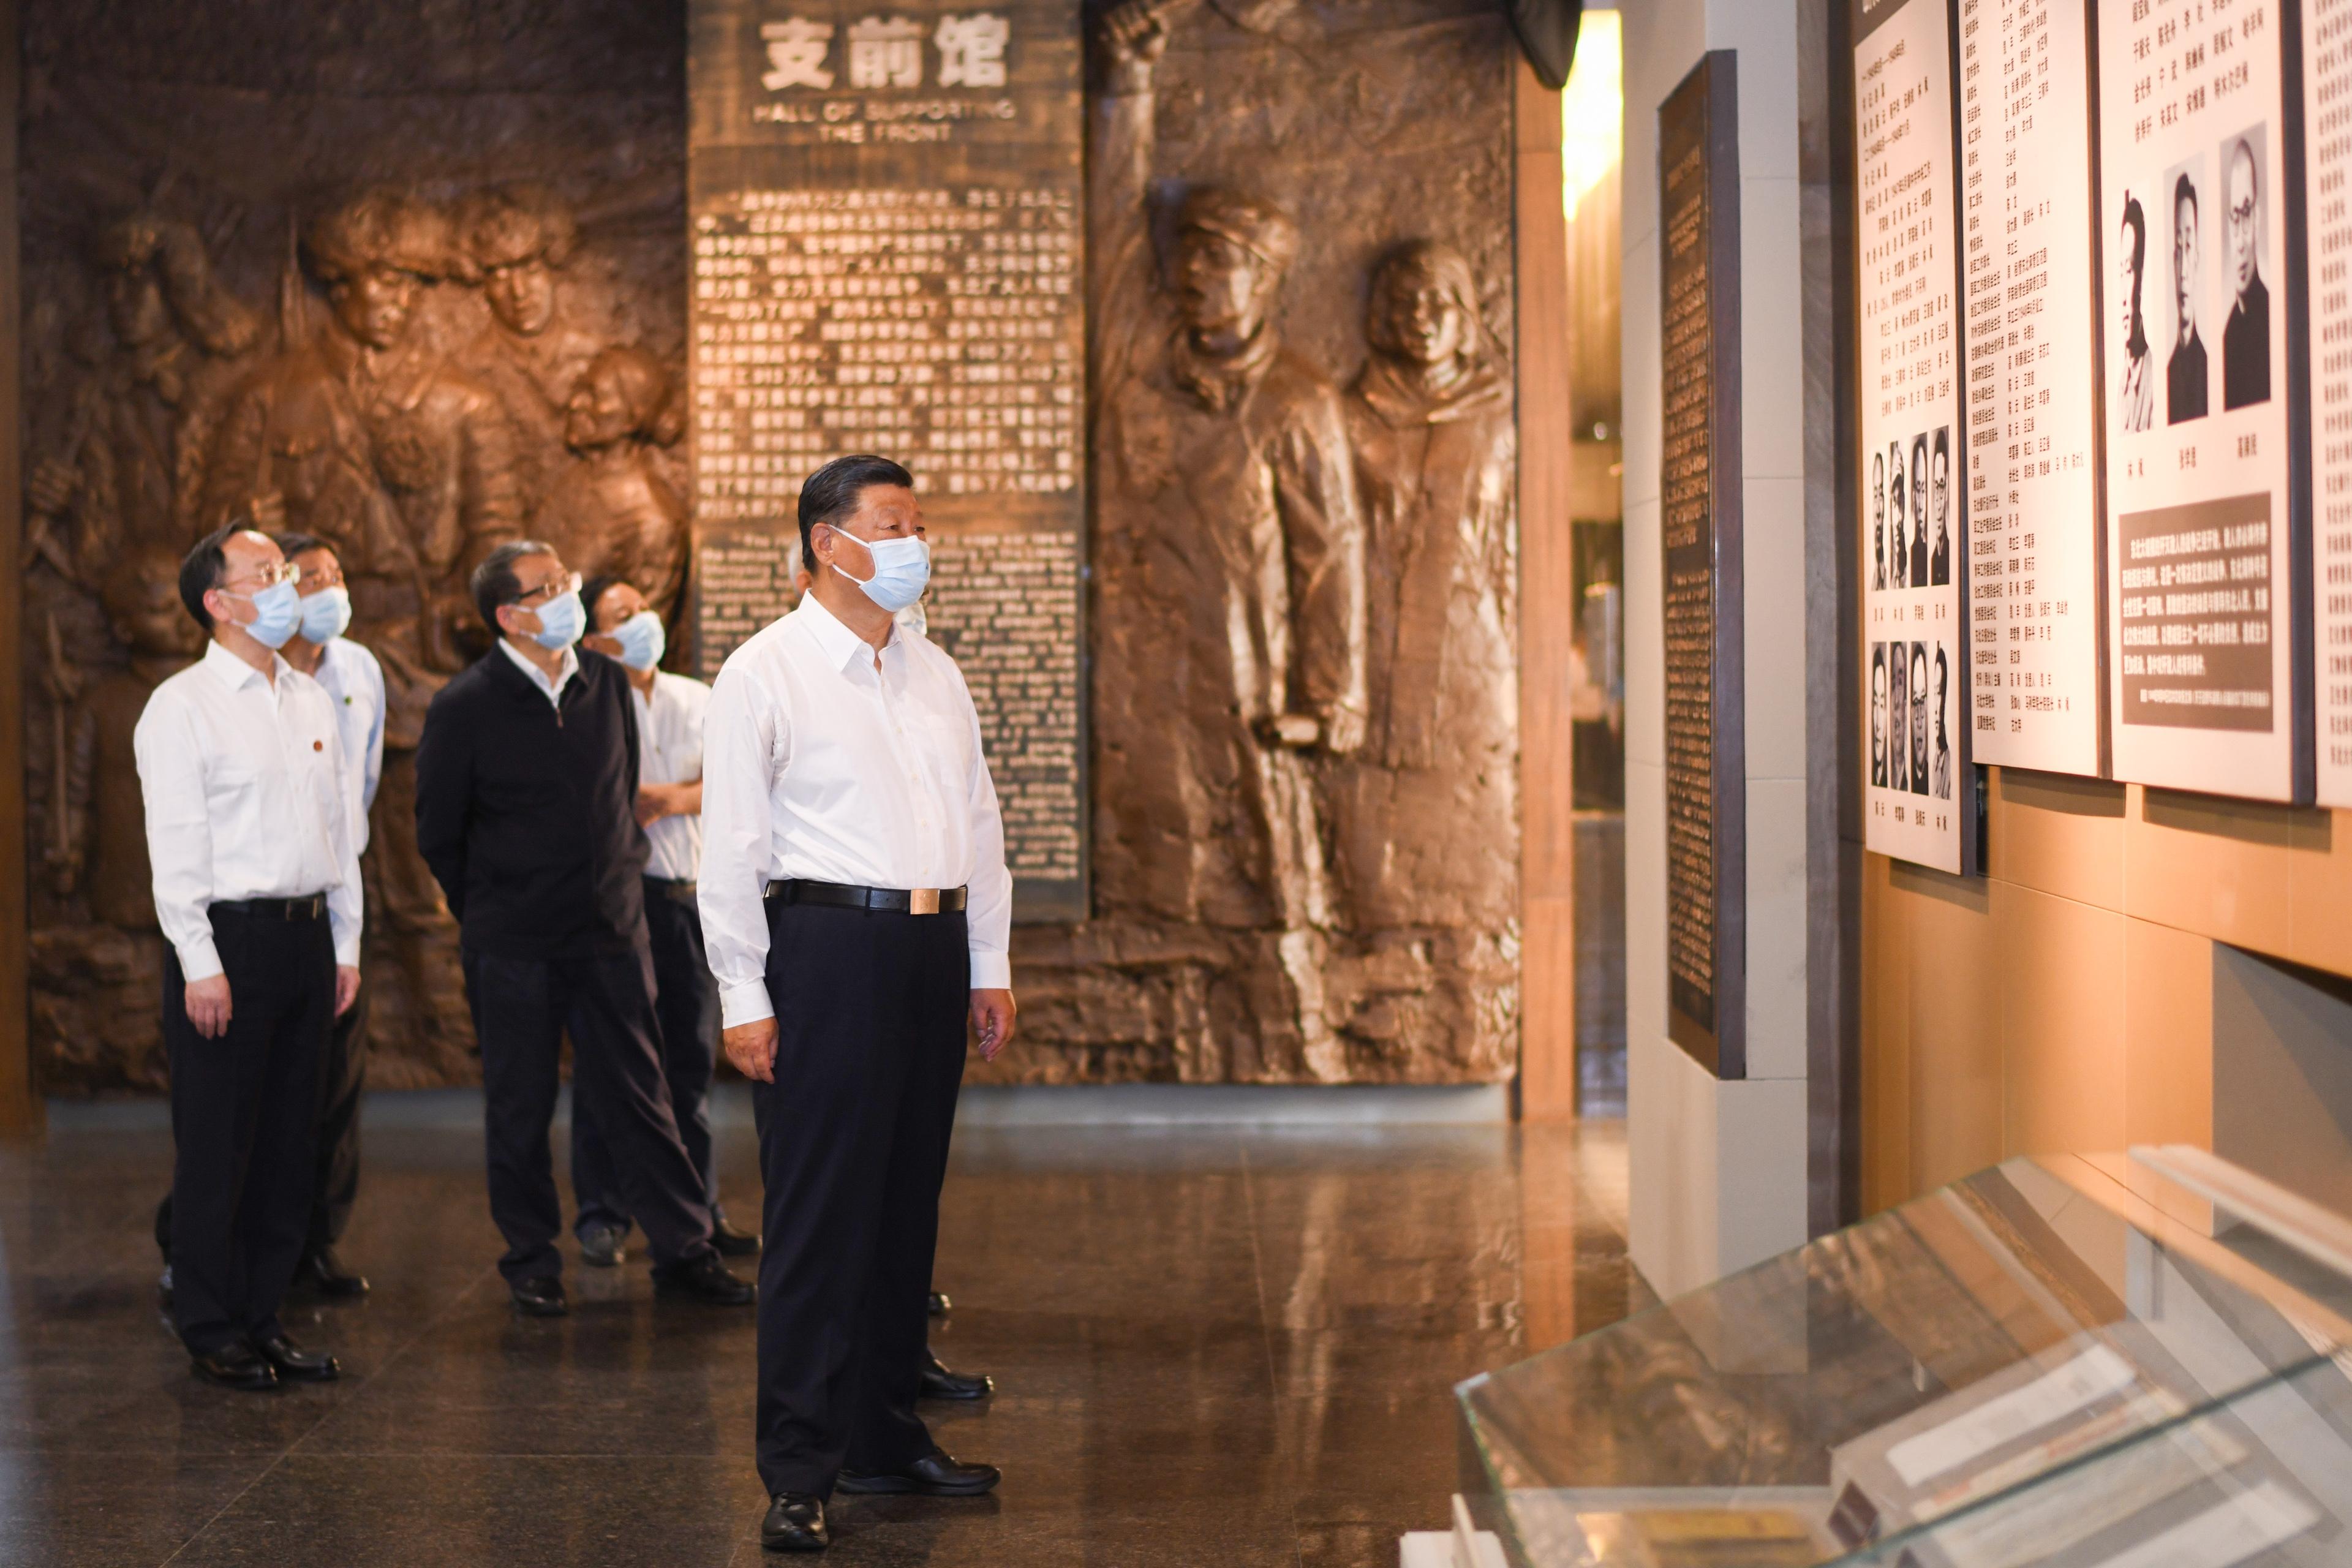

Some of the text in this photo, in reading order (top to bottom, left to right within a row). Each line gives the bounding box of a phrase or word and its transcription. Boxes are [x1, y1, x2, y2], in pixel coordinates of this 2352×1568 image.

[760, 13, 1011, 91] 支前馆
[753, 102, 815, 123] HALL
[823, 101, 856, 122] OF
[820, 123, 950, 143] THE FRONT
